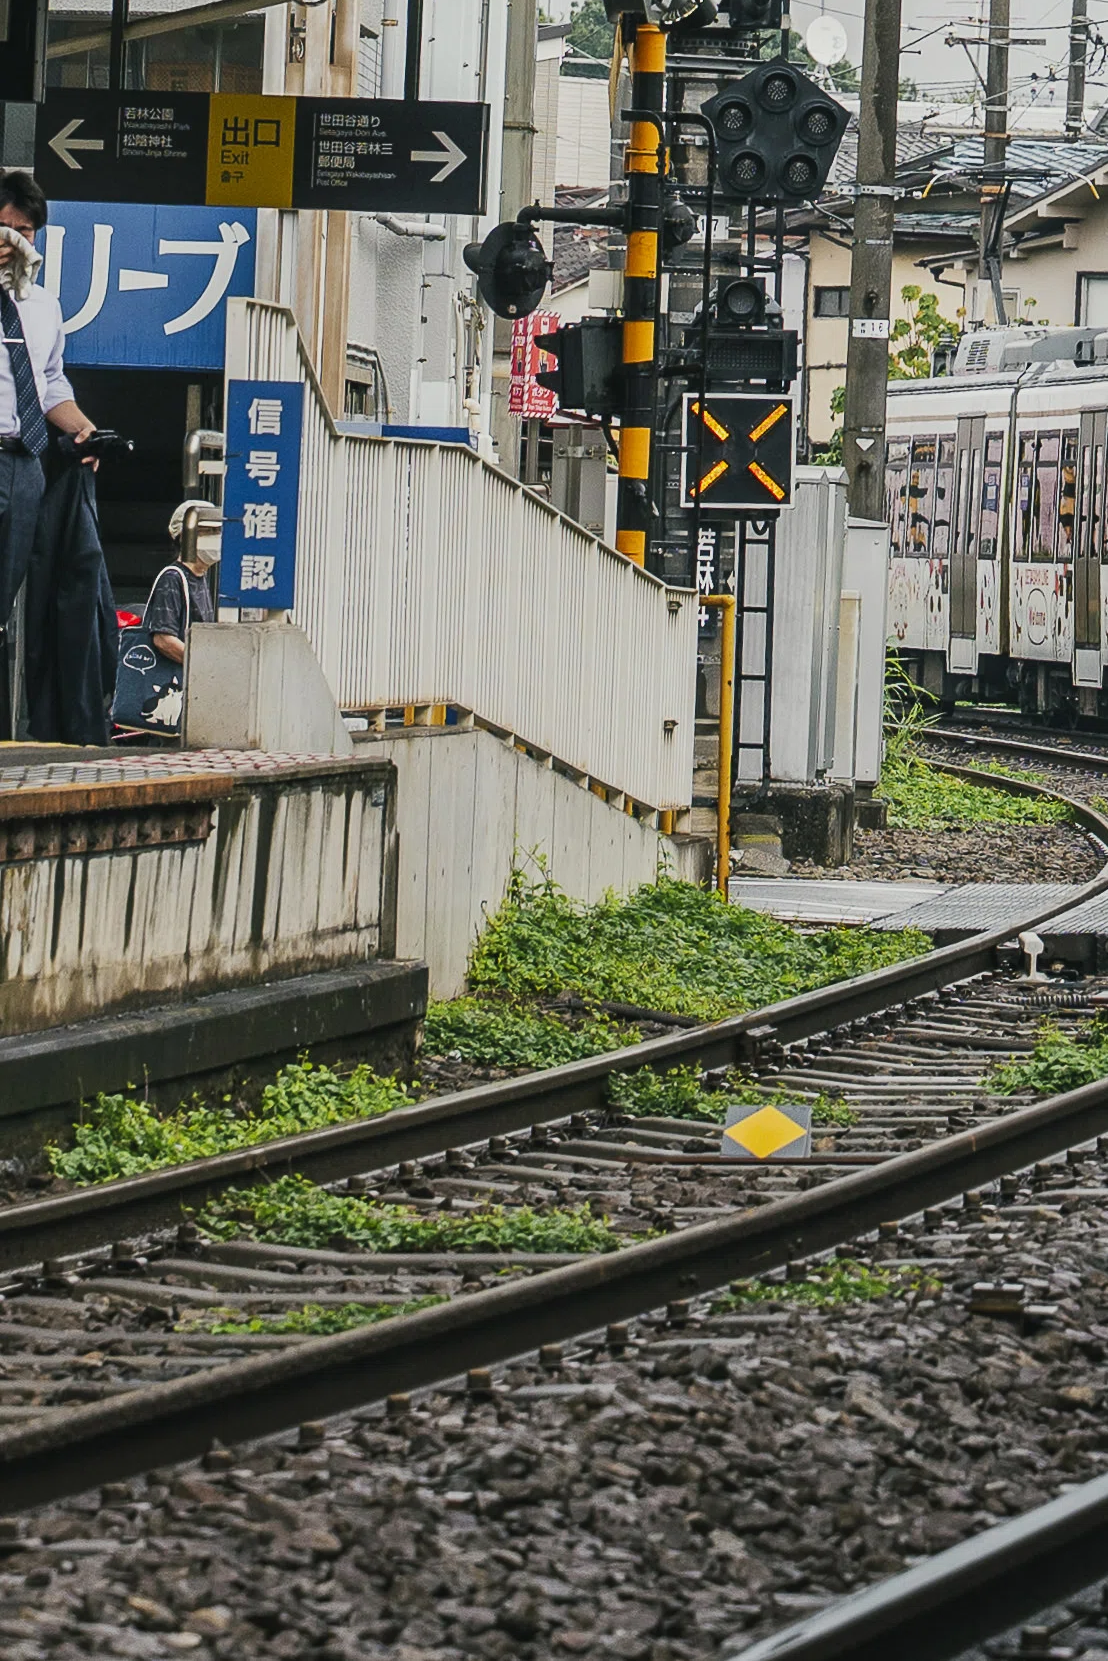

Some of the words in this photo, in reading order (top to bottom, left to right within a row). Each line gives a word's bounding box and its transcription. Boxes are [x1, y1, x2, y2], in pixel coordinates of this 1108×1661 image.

[124, 107, 174, 121] 若林公園
[320, 114, 381, 128] 世田谷通り
[221, 116, 281, 148] 出口
[319, 140, 393, 155] 世田谷若林三
[221, 149, 250, 165] Exit
[318, 155, 355, 169] 郵便局
[221, 170, 244, 184] 출구
[240, 397, 283, 591] 信号確認
